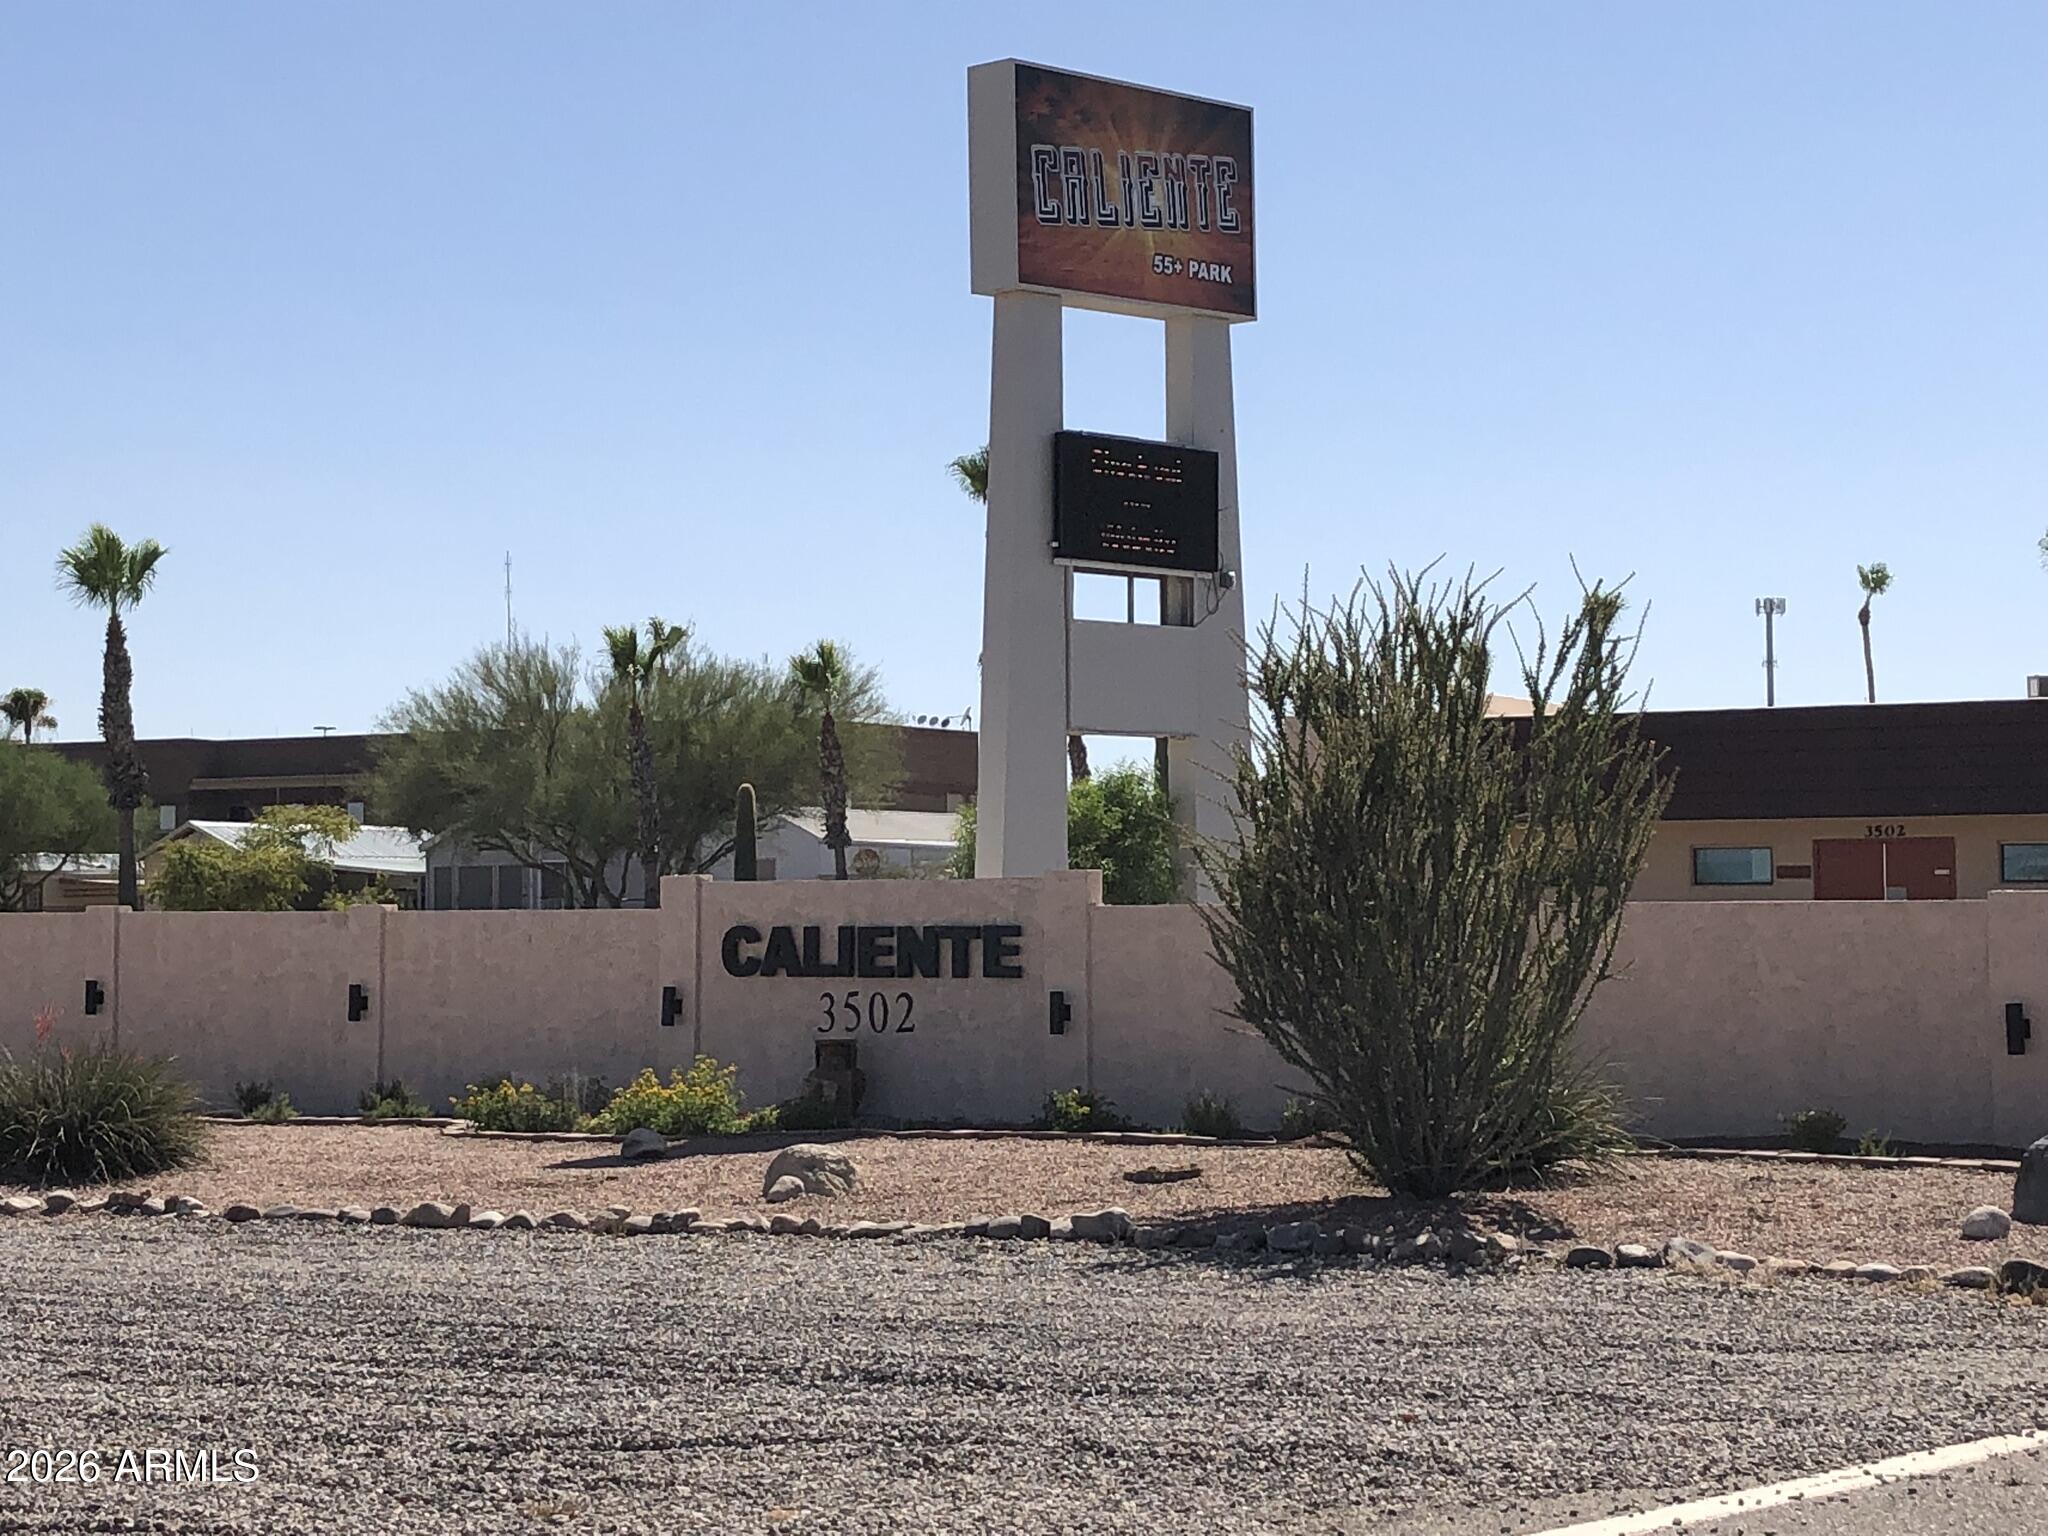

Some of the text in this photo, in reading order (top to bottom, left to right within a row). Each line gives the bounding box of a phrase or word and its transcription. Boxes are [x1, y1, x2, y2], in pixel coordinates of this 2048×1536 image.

[1031, 144, 1240, 233] CALIENTE
[1153, 255, 1232, 283] 55+ PARK
[1864, 825, 1906, 838] 3502
[721, 925, 1023, 978] CALIENTE
[817, 991, 916, 1033] 3502
